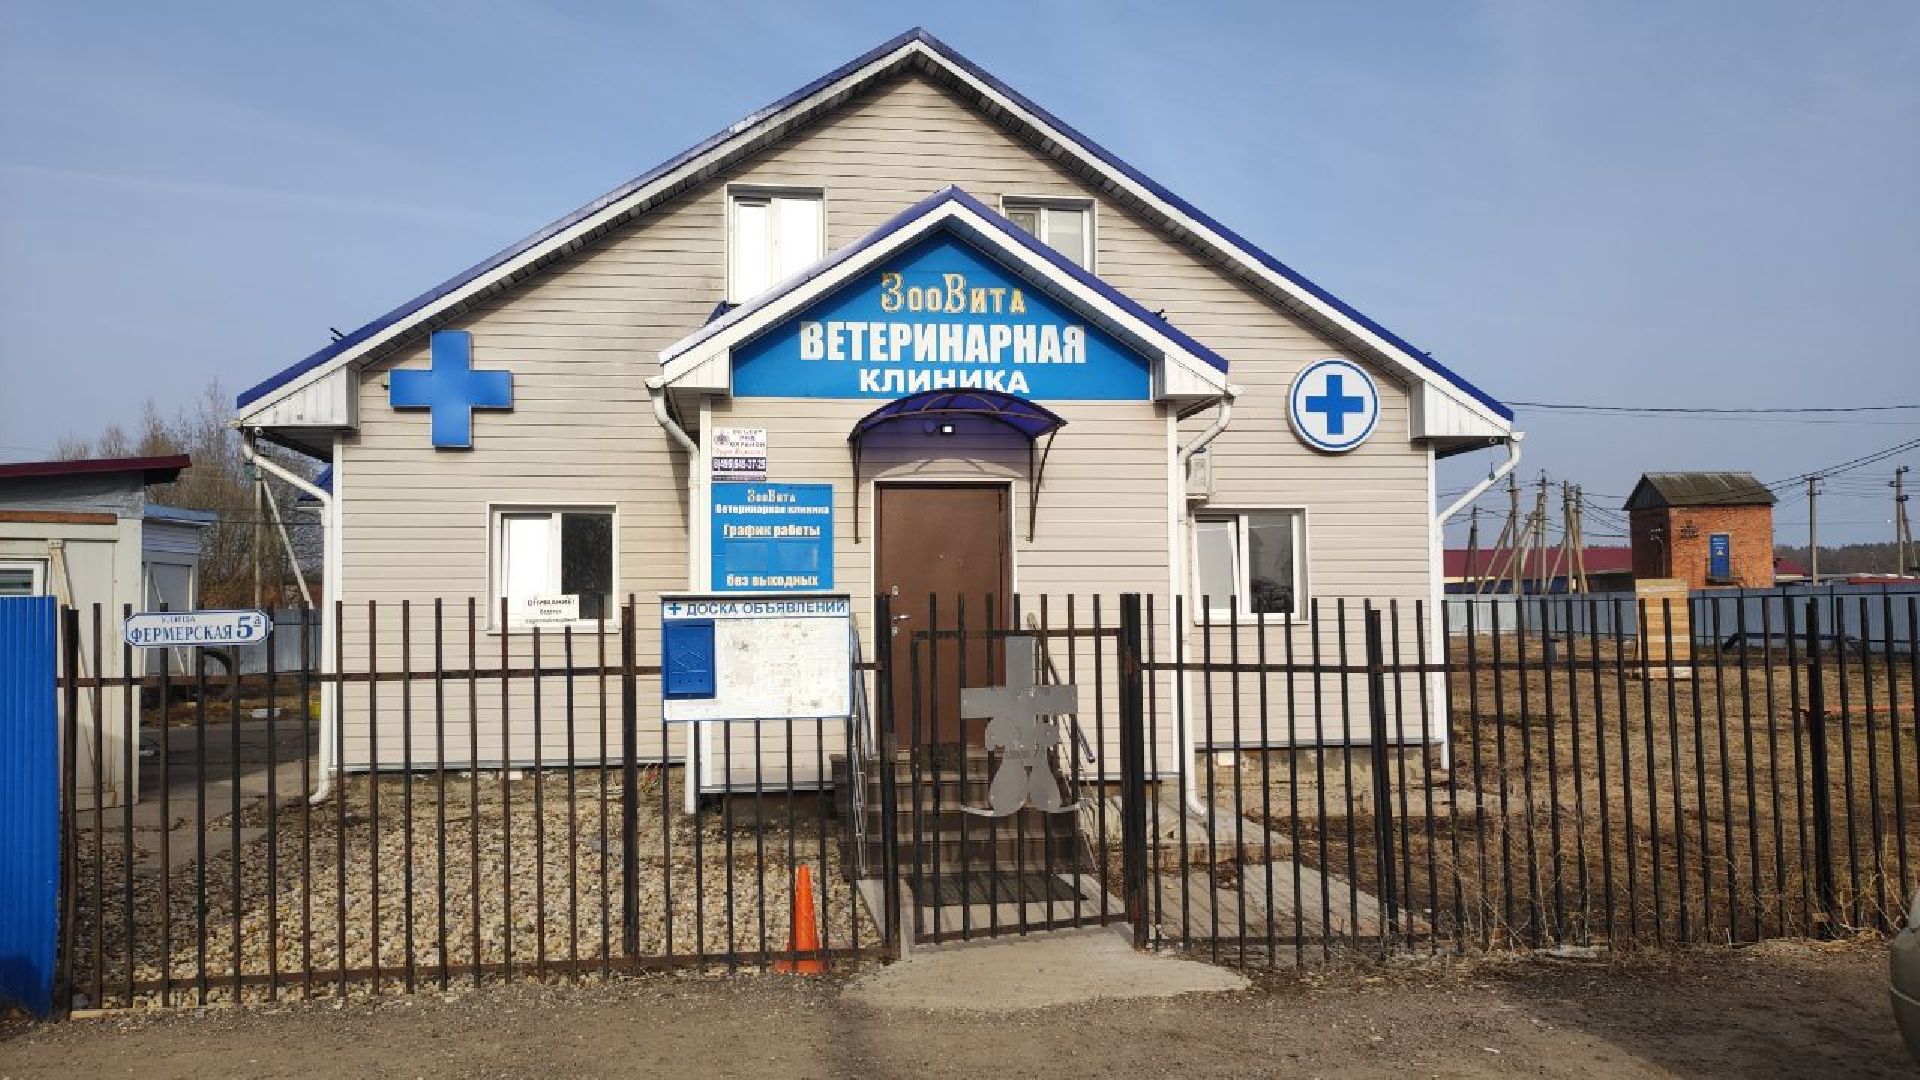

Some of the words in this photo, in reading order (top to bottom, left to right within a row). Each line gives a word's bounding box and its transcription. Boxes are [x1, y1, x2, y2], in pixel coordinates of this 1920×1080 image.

[800, 321, 1087, 364] ВЕТЕРИНАРНАЯ
[859, 369, 1030, 394] КЛИНИКА
[715, 504, 786, 515] Ветеринарная
[788, 504, 829, 515] клиника
[723, 525, 771, 538] График
[774, 525, 820, 538] работы
[752, 575, 818, 588] выходных
[687, 602, 738, 616] ДОСКА
[743, 600, 846, 614] ОБЪЯВЛЕНИЙ
[162, 615, 196, 623] УЛИЦА
[131, 624, 232, 643] ФЕРМЕРСКАЯ
